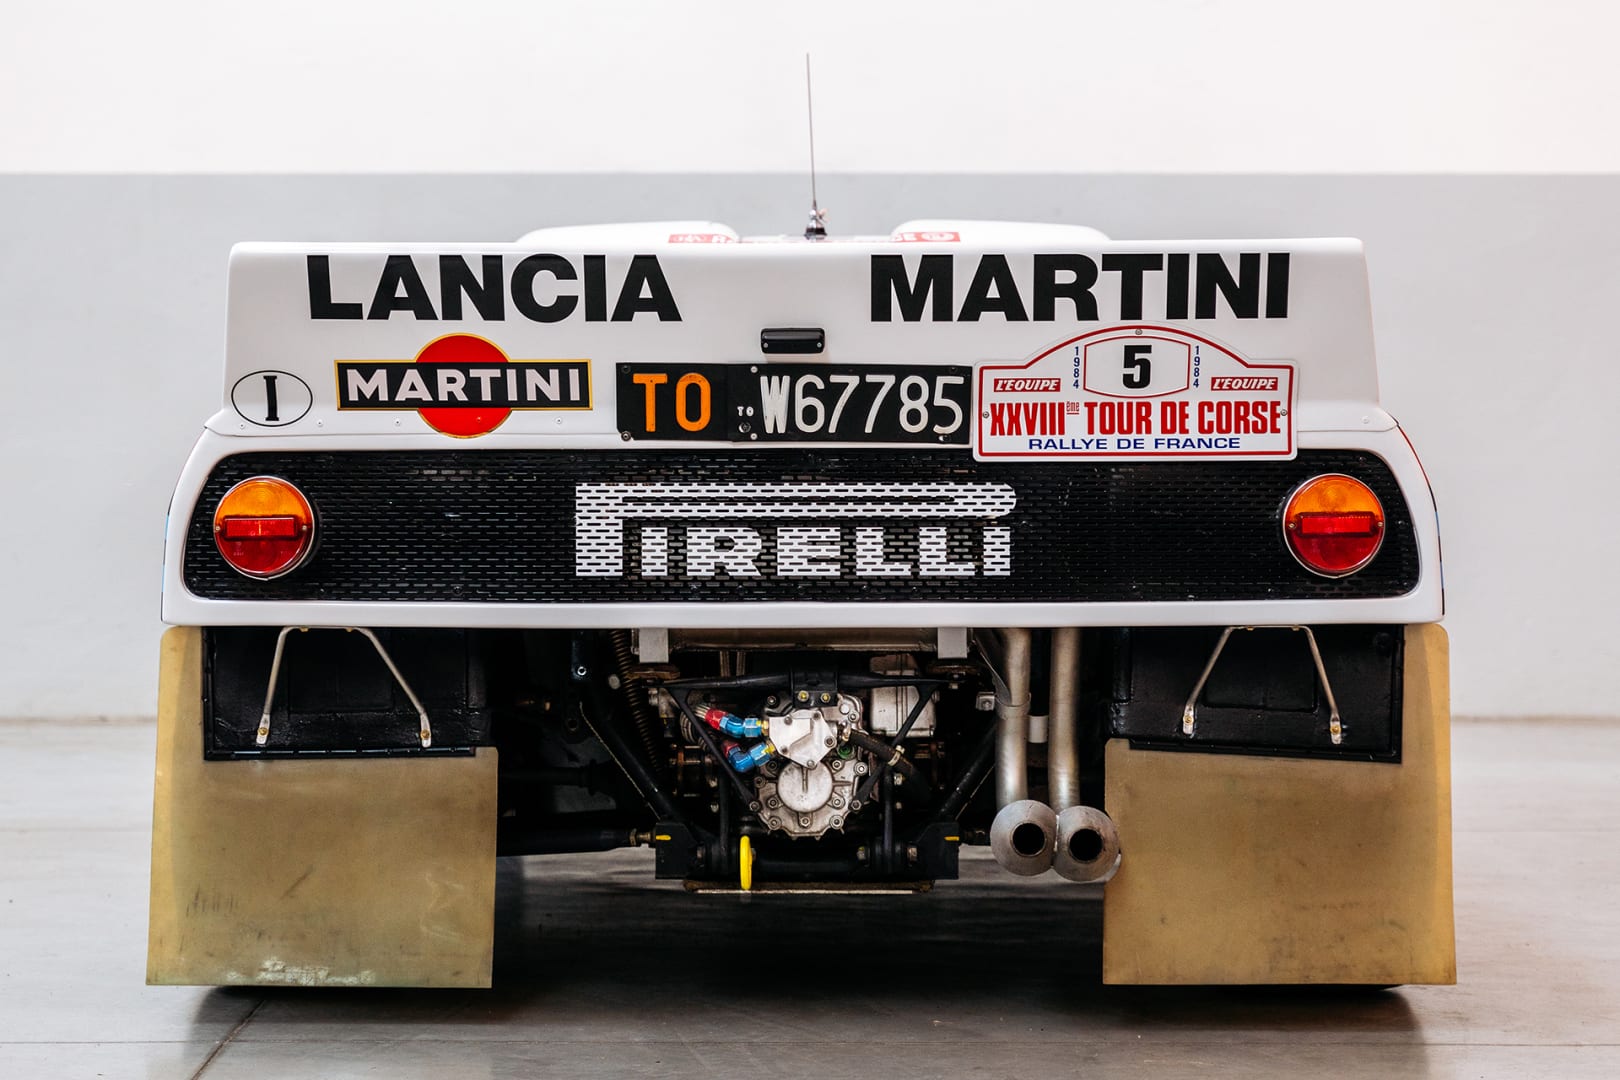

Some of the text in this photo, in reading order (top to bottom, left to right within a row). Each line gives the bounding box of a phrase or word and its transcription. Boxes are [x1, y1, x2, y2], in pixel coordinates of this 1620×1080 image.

[306, 252, 1291, 322] LANCIA MARTINI
[346, 369, 581, 401] MARTINI
[995, 379, 1059, 391] L'EQUIPE
[1072, 346, 1081, 389] 1984
[1122, 345, 1152, 389] 5
[1193, 345, 1201, 388] 1984
[1212, 378, 1277, 390] L'EQUIPE
[262, 375, 280, 422] I
[632, 372, 965, 435] TO W67785
[736, 405, 755, 417] TO
[1083, 401, 1152, 435] TOUR
[1160, 401, 1190, 435] DE
[1199, 400, 1281, 434] CORSE
[1028, 437, 1241, 450] RALLYE DE FRANCE
[575, 482, 1017, 577] PIRELLI
